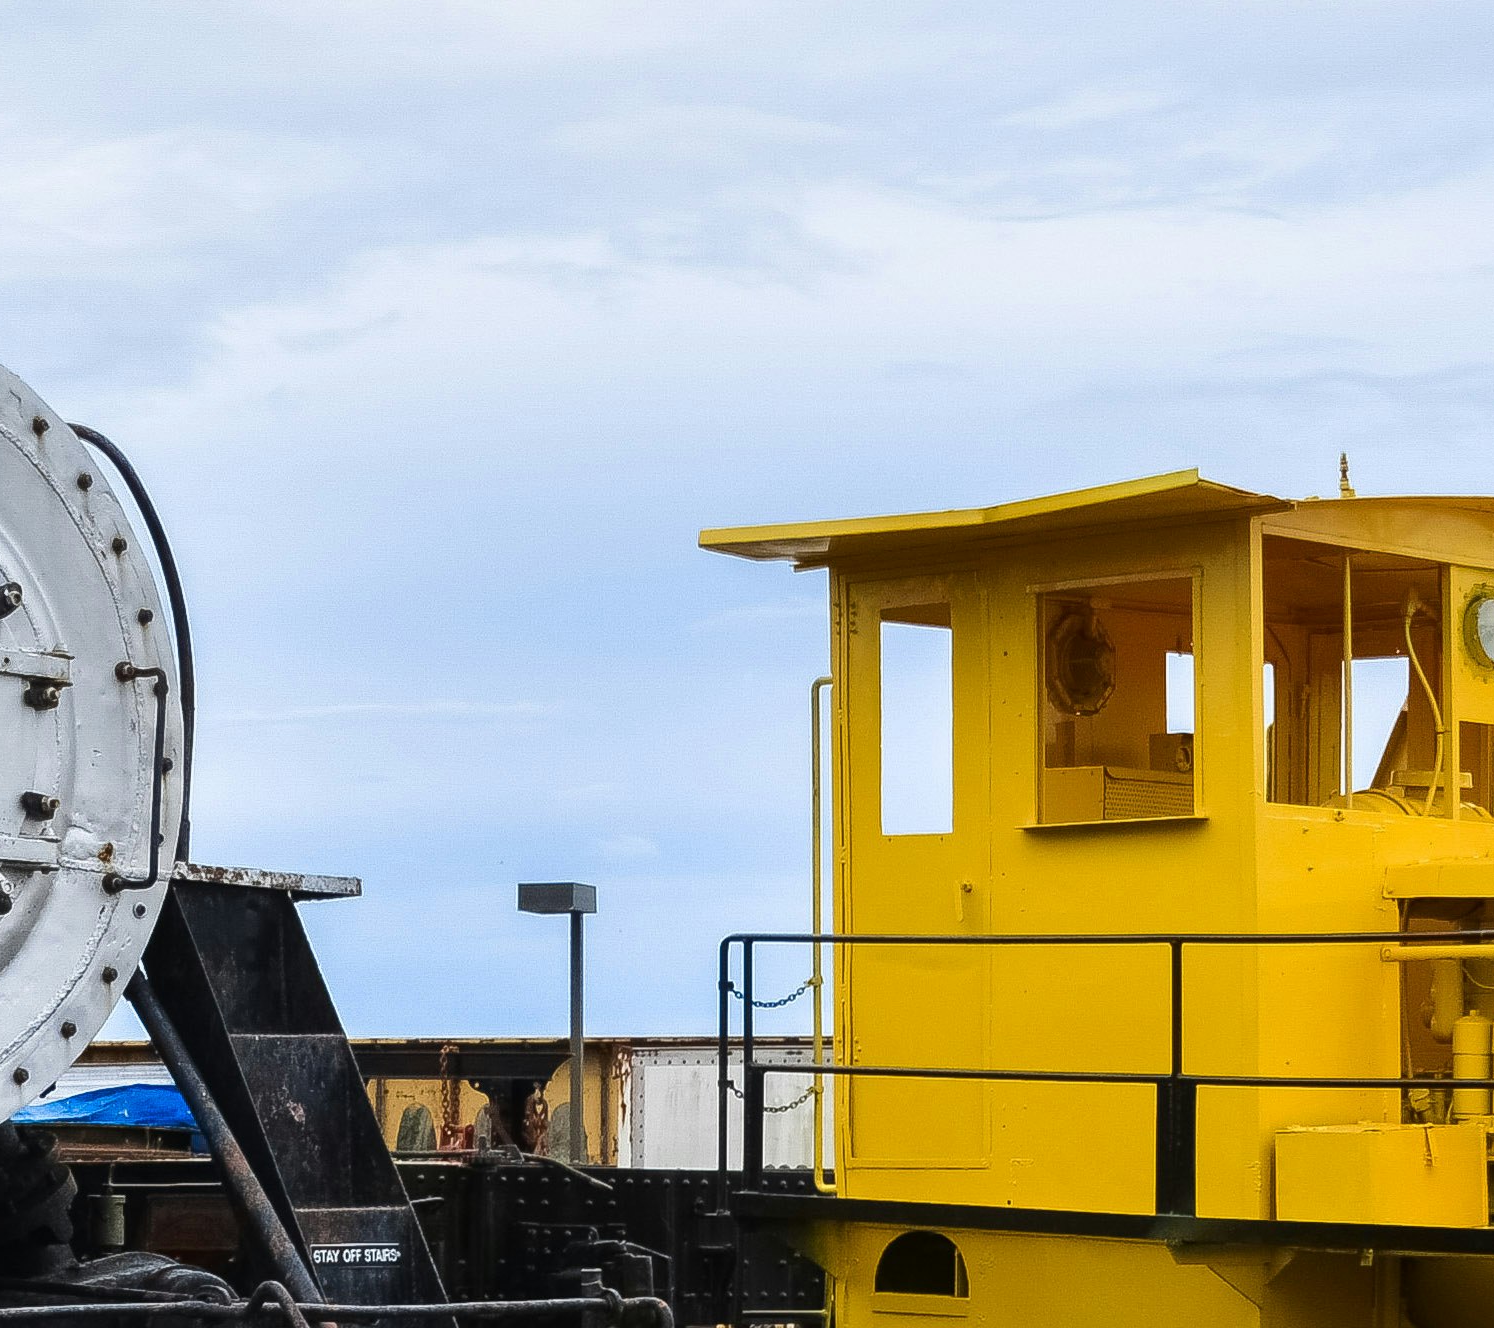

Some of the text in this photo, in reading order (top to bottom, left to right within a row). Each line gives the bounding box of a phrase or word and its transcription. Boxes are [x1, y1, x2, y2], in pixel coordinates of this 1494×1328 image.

[313, 1248, 398, 1264] STAY OFF STAIRS
